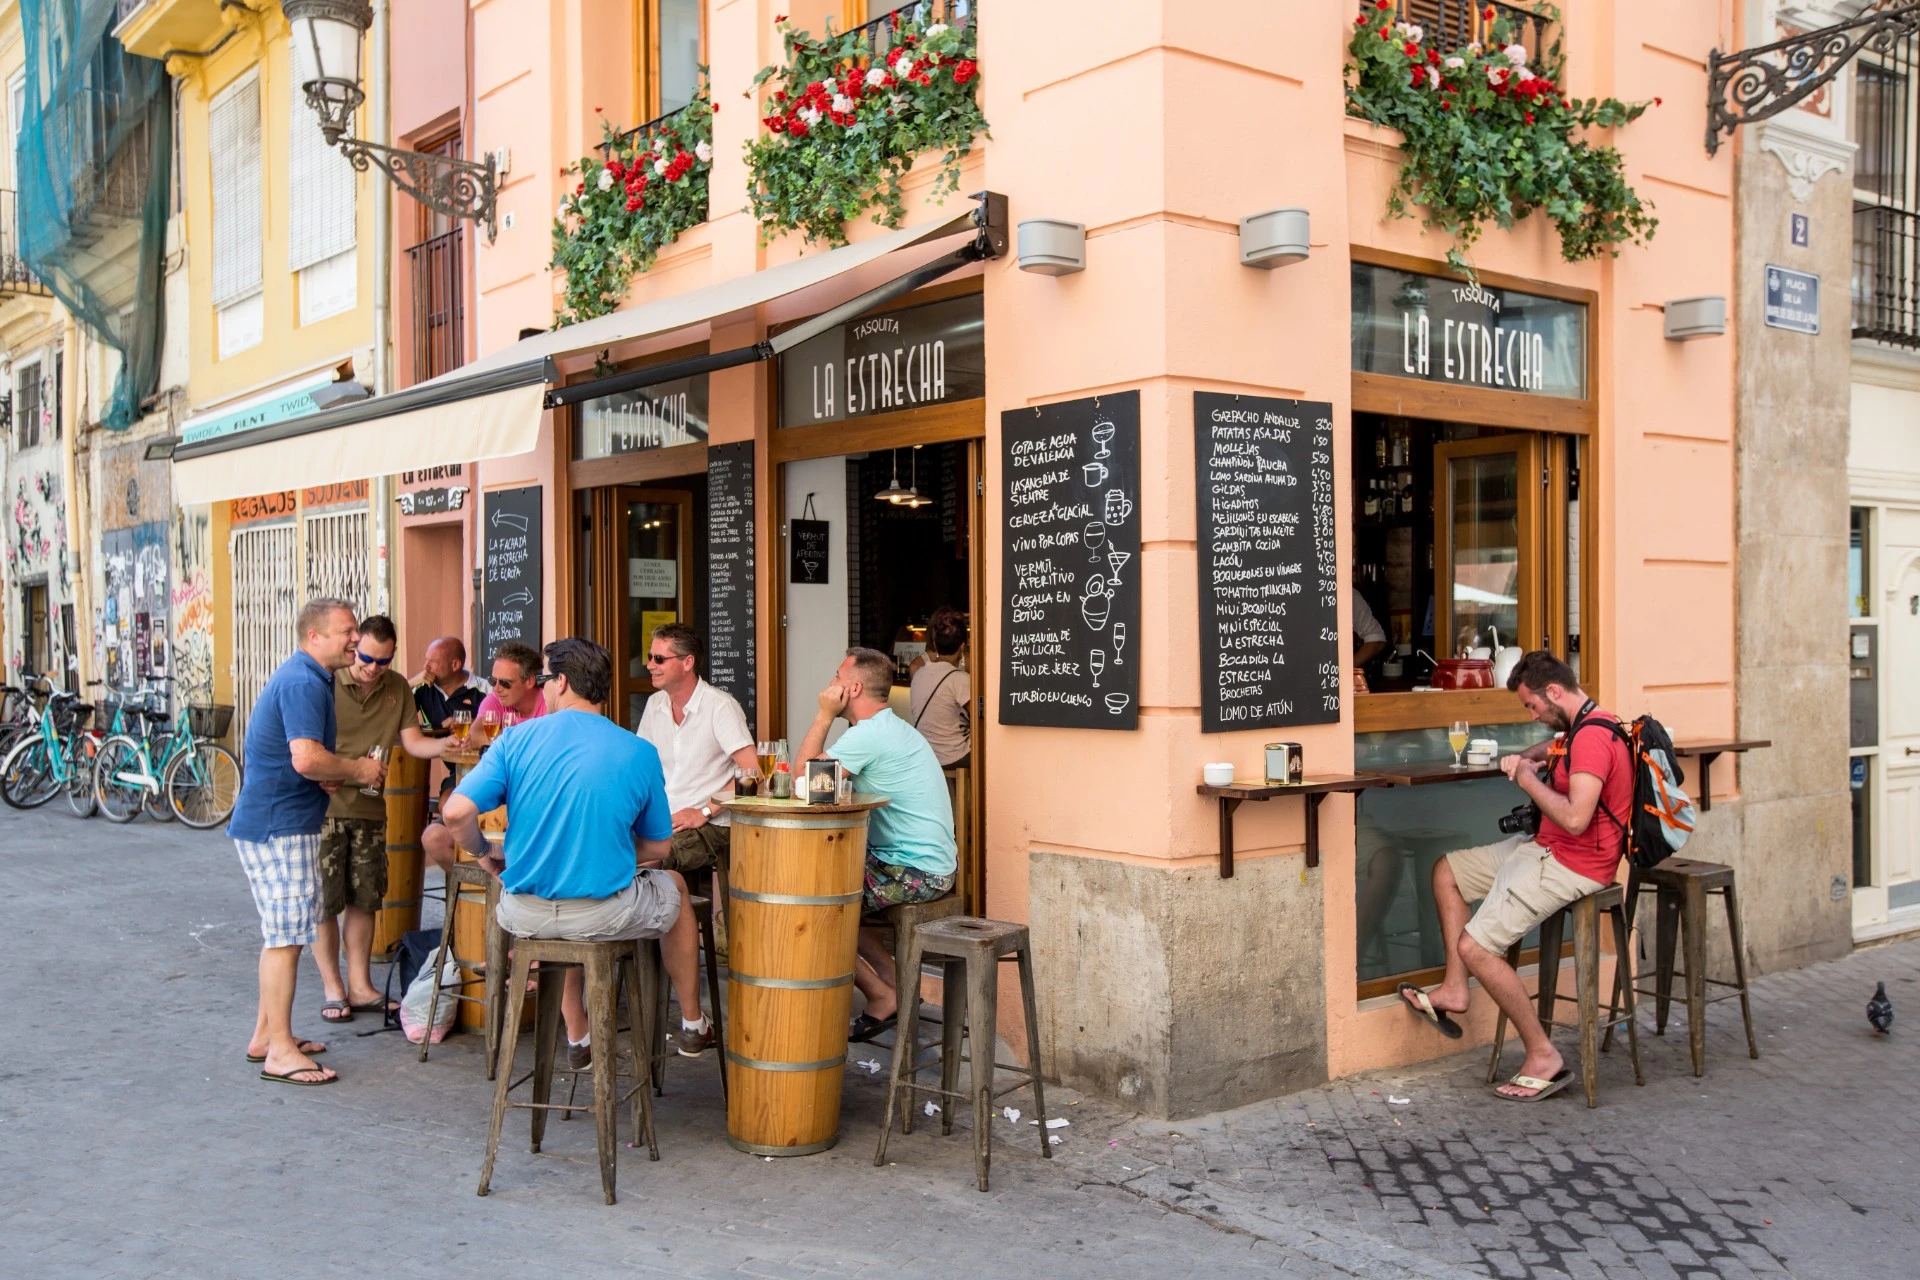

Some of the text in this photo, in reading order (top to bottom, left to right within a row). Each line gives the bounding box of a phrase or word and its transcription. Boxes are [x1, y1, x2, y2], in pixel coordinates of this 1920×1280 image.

[505, 215, 511, 228] 6
[1796, 218, 1805, 242] 2
[1451, 287, 1501, 313] TASQUITA
[853, 318, 900, 341] TASQUITA
[1404, 312, 1543, 390] LA ESTRECHA
[813, 340, 945, 419] LA ESTRECHA
[597, 392, 687, 454] LA ESTRECHA
[1212, 409, 1259, 423] GAZPACHO
[1264, 411, 1300, 429] ANDALUZ
[1212, 426, 1251, 440] PATATAS
[1253, 427, 1291, 443] ASADAS
[1011, 433, 1078, 455] COPA DE AGUA
[1213, 441, 1260, 457] MOLLEJAS
[1014, 446, 1075, 467] DE VALENCIA
[1020, 471, 1058, 493] SANGRIA
[1059, 470, 1071, 483] DE
[1210, 471, 1231, 482] LOMO
[1234, 471, 1262, 483] SARDINA
[307, 479, 368, 505] SOUVENI
[1011, 490, 1050, 507] SIEMPRE
[1212, 483, 1246, 497] GILDAS
[232, 491, 297, 519] REGALOS
[1212, 496, 1260, 510] HIGADITOS
[1010, 510, 1055, 528] CERVEZA
[1057, 503, 1094, 520] GLACIAL
[1212, 511, 1254, 524] MEJILLONES
[1257, 513, 1267, 523] EN
[1270, 512, 1300, 523] ESCABECHE
[1213, 524, 1260, 539] SARDINITAS
[1263, 526, 1272, 536] EN
[1272, 524, 1295, 536] ACEITE
[489, 538, 497, 551] LA
[1012, 532, 1079, 552] VINO POR COPAS
[1212, 538, 1252, 553] GAMBITA
[1255, 538, 1281, 550] COCIDA
[500, 549, 528, 567] ESTRECHA
[1213, 553, 1243, 568] LACÓN
[1014, 559, 1052, 577] VERMUT
[1213, 567, 1264, 584] BOQUERONES
[1265, 566, 1275, 577] EN
[1277, 562, 1302, 576] VINAGRE
[1019, 566, 1075, 590] APERITIVO
[1012, 591, 1071, 609] CASSALLA EN
[1214, 585, 1259, 598] TOMATITO
[1013, 606, 1045, 622] BOTIJO
[1216, 600, 1239, 616] MINI
[1240, 600, 1287, 616] BOCADILLOS
[489, 611, 497, 625] LA
[1219, 617, 1282, 634] MINI ESPECIAL
[1012, 628, 1070, 646] MANZANILLA DE
[1220, 636, 1233, 649] LA
[1235, 634, 1284, 649] ESTRECHA
[1012, 644, 1066, 657] SAN LUCAR
[1219, 651, 1285, 667] BOCADILLO LA
[1011, 659, 1080, 677] FINO DE JEREZ
[1219, 669, 1271, 686] ESTRECHA
[1010, 688, 1092, 707] TURBIO EN CUENCO
[1220, 685, 1262, 701] BROCHETAS
[1220, 705, 1247, 721] LOMO
[1250, 705, 1263, 718] DE
[1266, 699, 1293, 717] ATÚN
